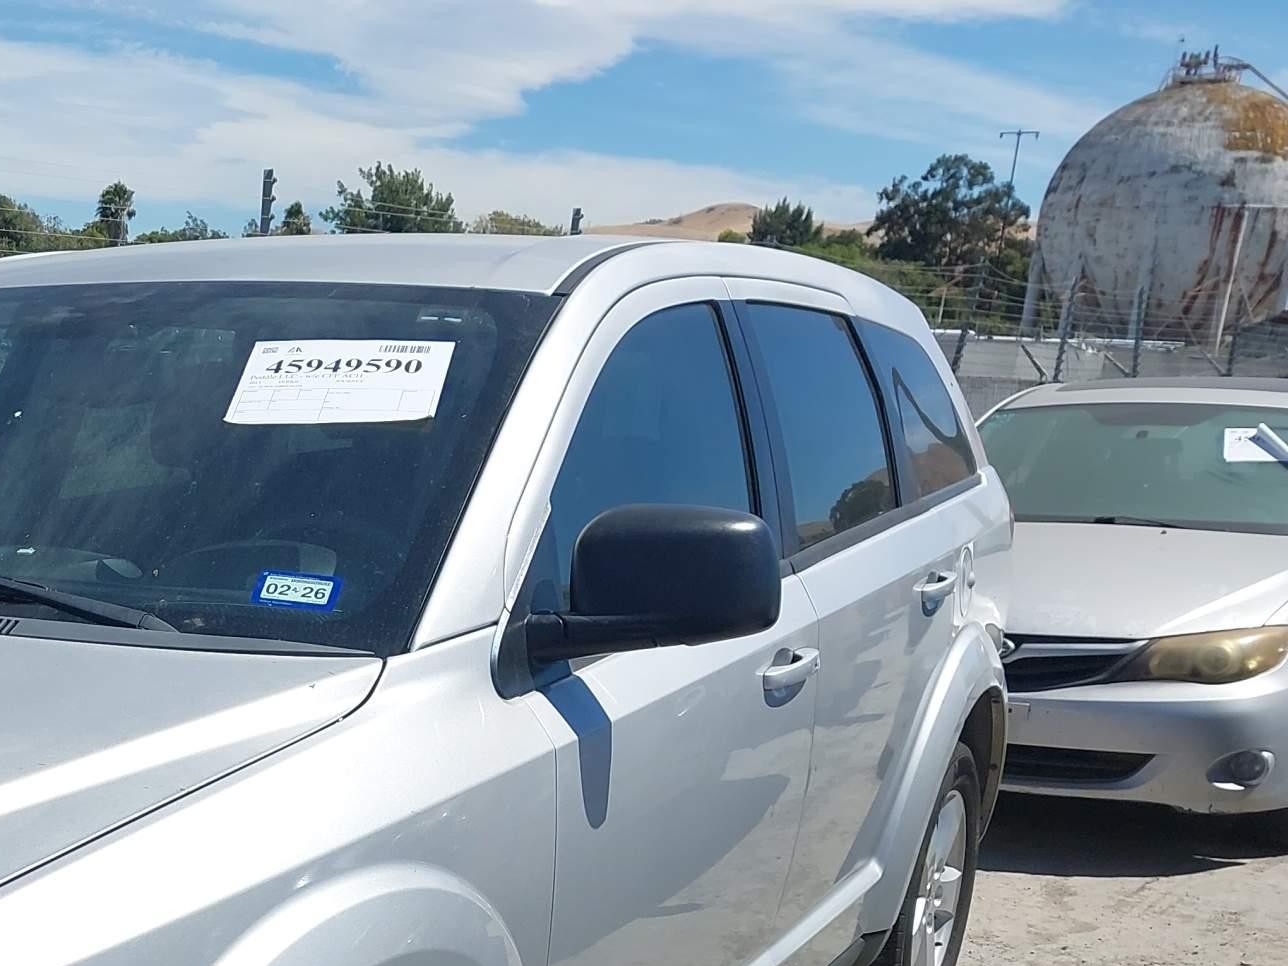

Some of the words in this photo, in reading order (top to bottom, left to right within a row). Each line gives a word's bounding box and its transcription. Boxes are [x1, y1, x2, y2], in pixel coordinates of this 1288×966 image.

[265, 358, 423, 375] 45949590
[266, 583, 292, 596] 02
[301, 586, 328, 600] 26
